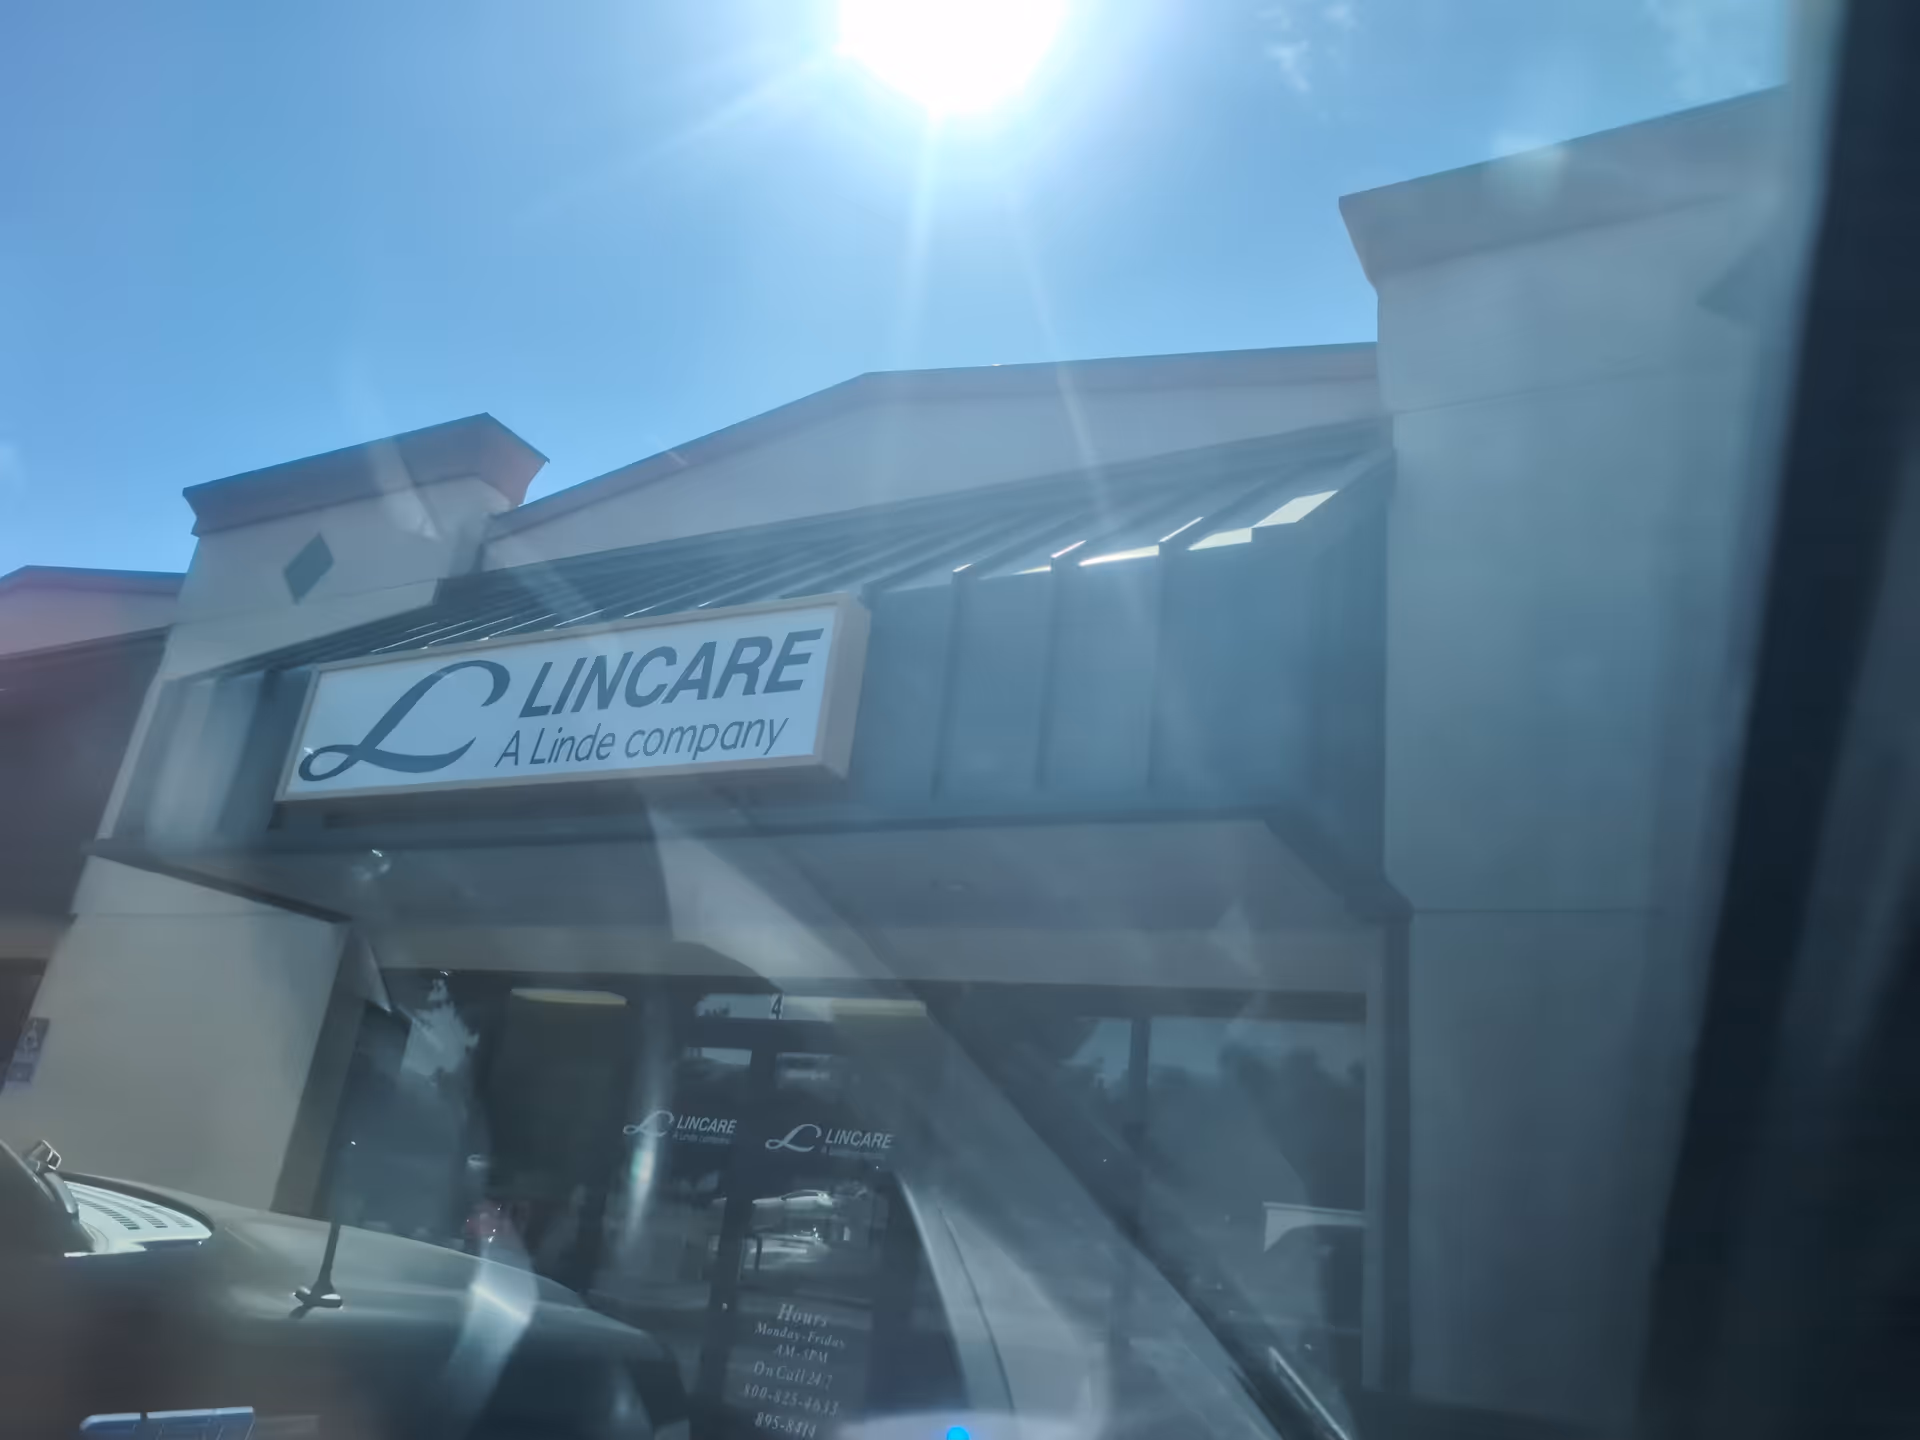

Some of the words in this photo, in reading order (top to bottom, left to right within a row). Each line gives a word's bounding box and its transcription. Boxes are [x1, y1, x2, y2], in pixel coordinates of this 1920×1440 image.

[519, 627, 825, 718] LINCARE
[494, 728, 520, 768] A
[529, 722, 613, 765] Linde
[624, 717, 790, 760] company
[770, 993, 783, 1020] 4
[676, 1114, 738, 1135] LINCARE
[824, 1128, 896, 1149] LINCARE
[776, 1303, 829, 1328] Hours
